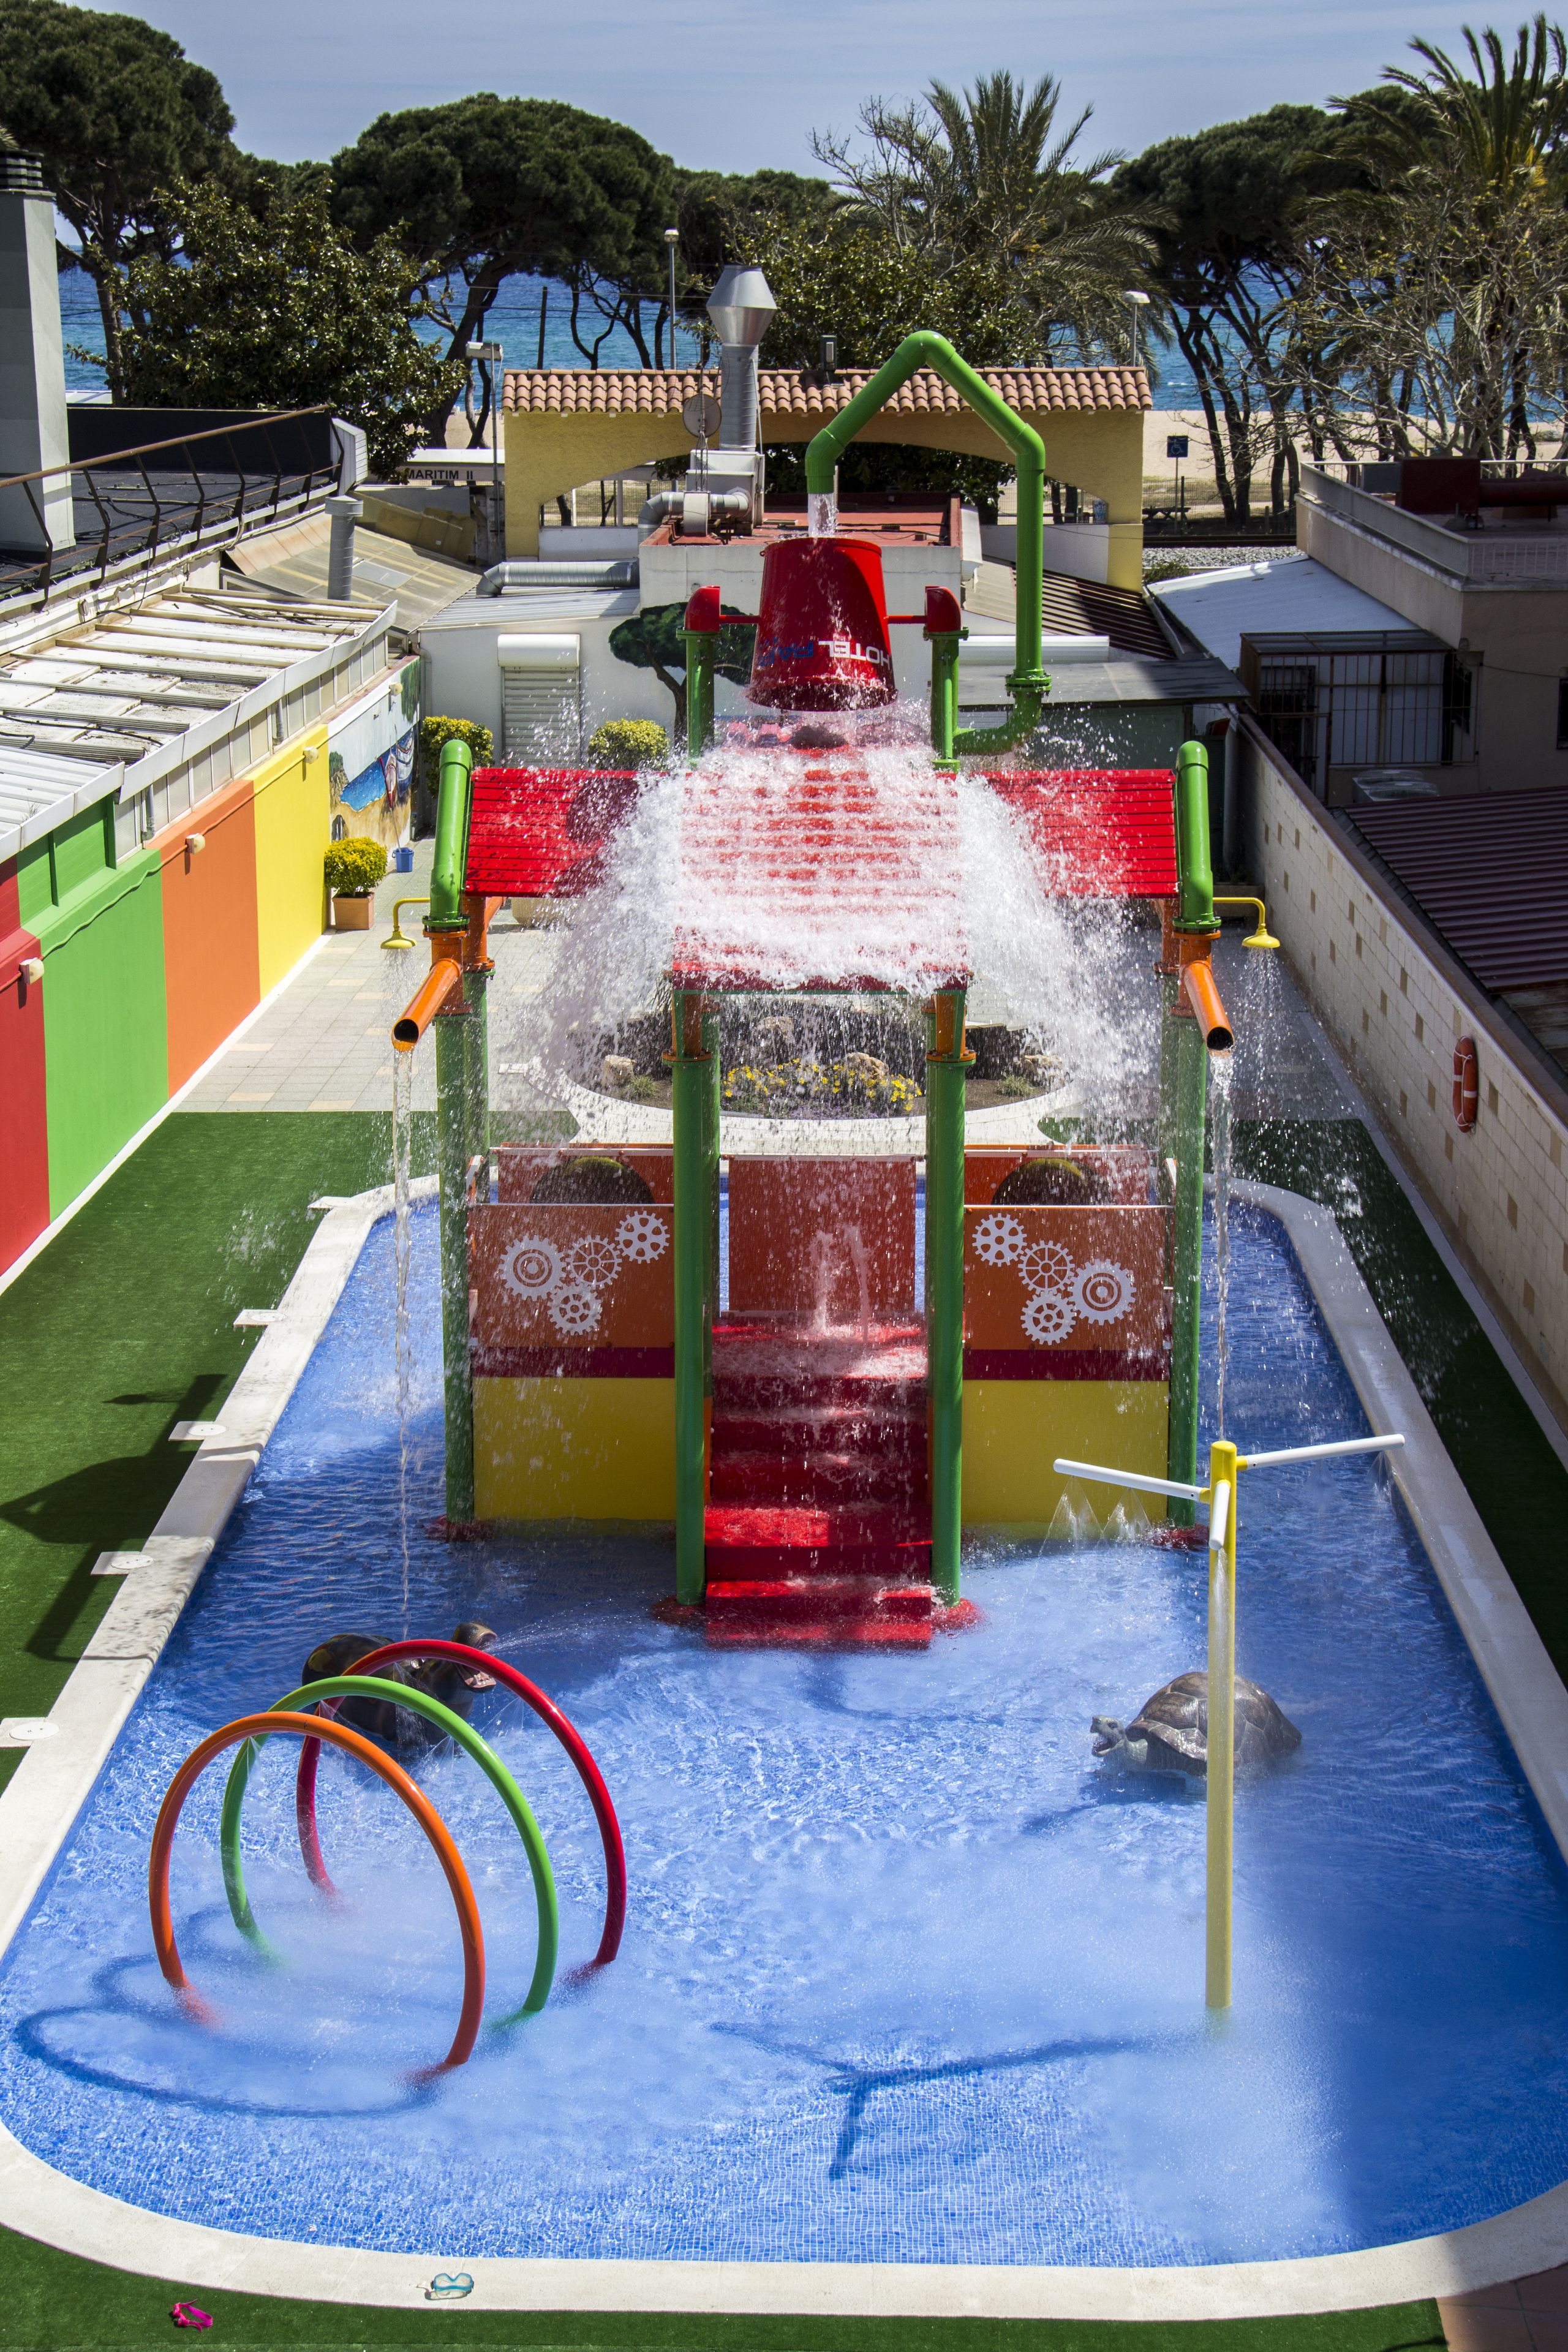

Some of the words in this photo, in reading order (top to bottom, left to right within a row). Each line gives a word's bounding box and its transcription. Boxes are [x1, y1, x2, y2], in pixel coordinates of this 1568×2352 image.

[407, 469, 459, 479] MARITIM
[466, 470, 473, 480] II
[818, 640, 890, 670] HOTEL
